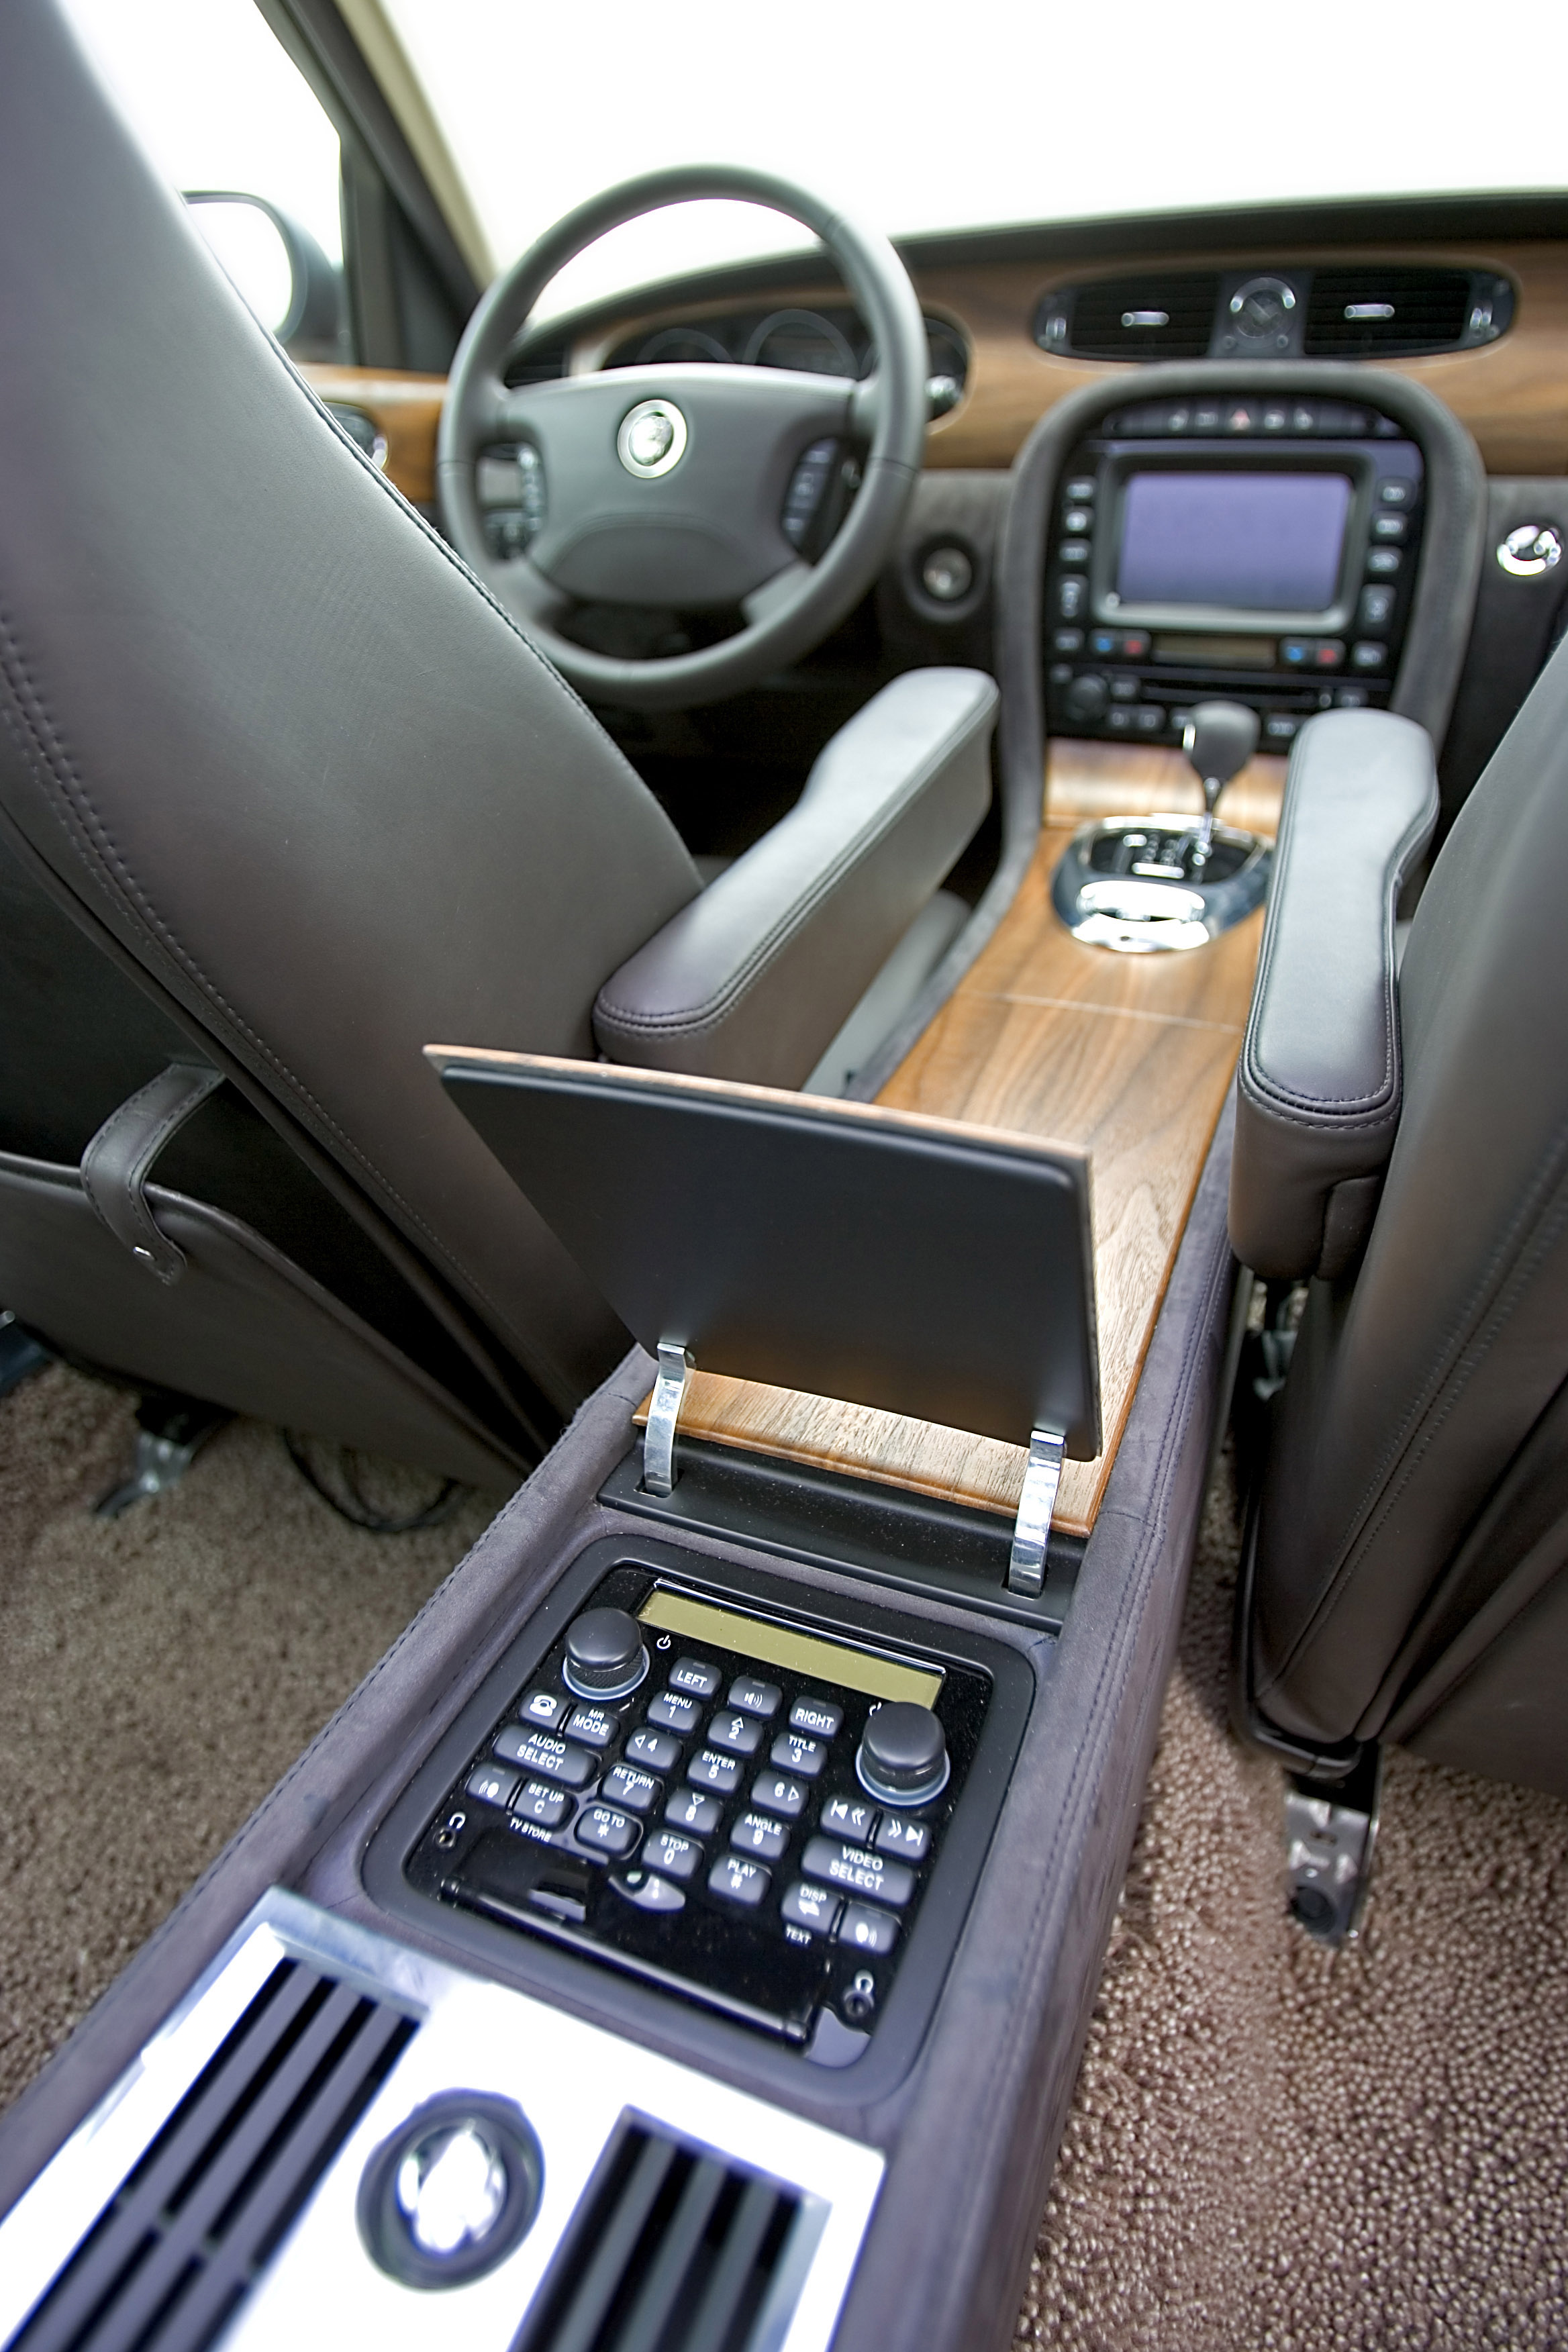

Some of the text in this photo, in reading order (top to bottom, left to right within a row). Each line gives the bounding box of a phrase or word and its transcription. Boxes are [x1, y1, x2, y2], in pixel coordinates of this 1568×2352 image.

[677, 1669, 707, 1688] LEFT
[663, 1692, 692, 1710] MENU
[588, 1708, 605, 1721] MR
[669, 1705, 677, 1718] 1
[795, 1710, 834, 1730] RIGHT
[573, 1714, 609, 1736] MODE
[728, 1727, 740, 1740] 2
[528, 1733, 566, 1754] AUDIO
[647, 1738, 658, 1752] 4
[789, 1734, 816, 1753] TITLE
[516, 1744, 564, 1771] SELECT
[701, 1751, 736, 1770] ENTER
[792, 1749, 802, 1763] 3
[612, 1767, 654, 1790] RETURN
[708, 1765, 719, 1779] 5
[528, 1782, 565, 1804] SET UP
[622, 1783, 633, 1796] 7
[774, 1782, 785, 1798] 6
[534, 1800, 545, 1814] C
[593, 1808, 625, 1828] GO TO
[744, 1814, 783, 1836] ANGLE
[509, 1817, 552, 1843] TV STORE
[660, 1834, 689, 1852] STOP
[842, 1845, 883, 1870] VIDEO
[728, 1858, 756, 1878] PLAY
[830, 1860, 884, 1891] SELECT
[799, 1885, 827, 1903] DISP
[785, 1923, 812, 1945] TEXT
